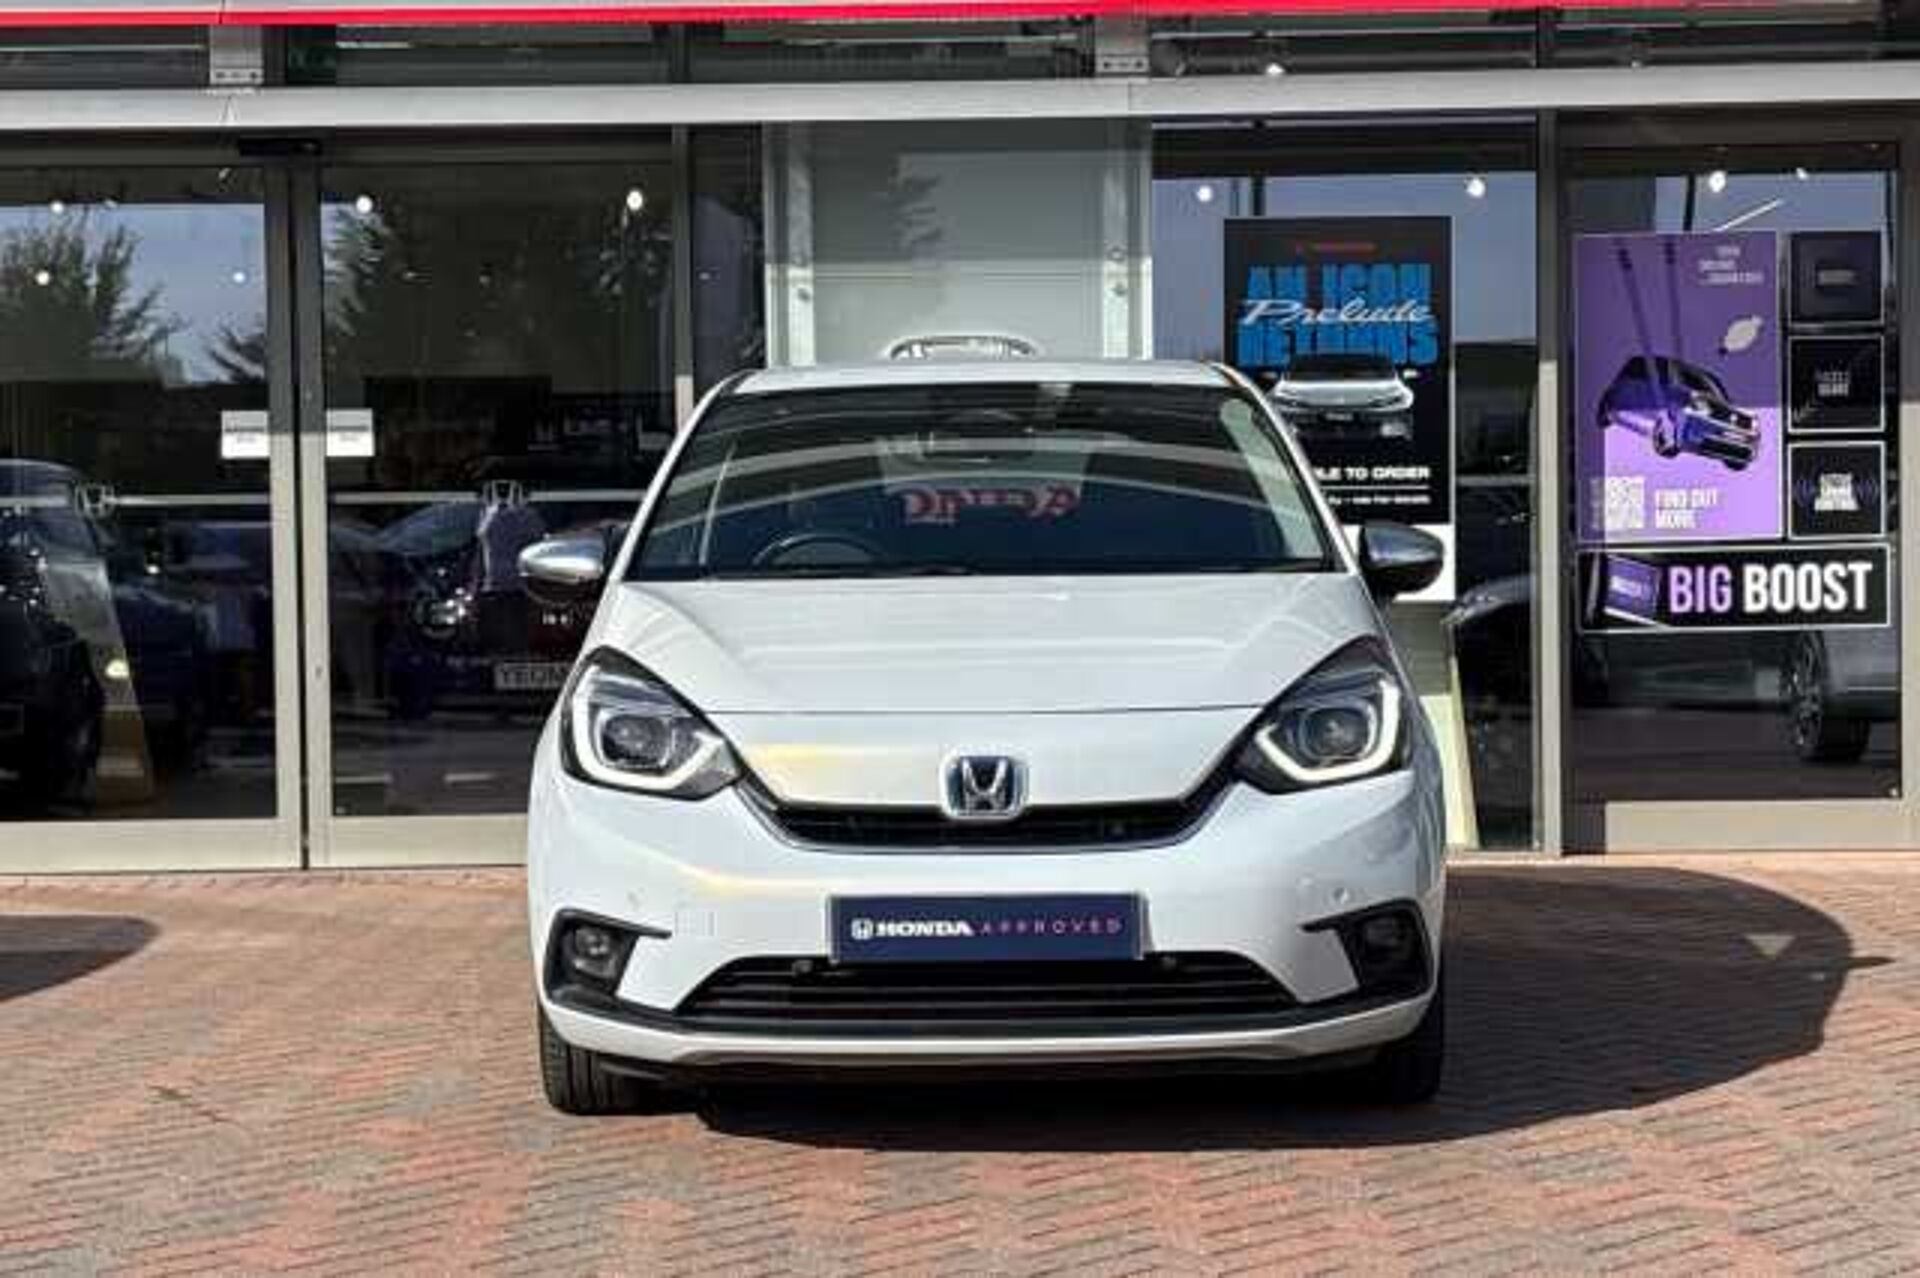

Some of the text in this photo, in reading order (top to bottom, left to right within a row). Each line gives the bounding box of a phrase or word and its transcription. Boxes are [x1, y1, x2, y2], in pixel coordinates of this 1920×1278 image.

[1238, 293, 1437, 325] Prelude
[1344, 467, 1369, 480] TO
[1371, 466, 1430, 479] ORDER
[1655, 487, 1718, 508] FIND OUT
[1668, 565, 1732, 613] BIG
[1743, 561, 1873, 611] BOOST
[876, 917, 1122, 937] HONDA APPROVED
